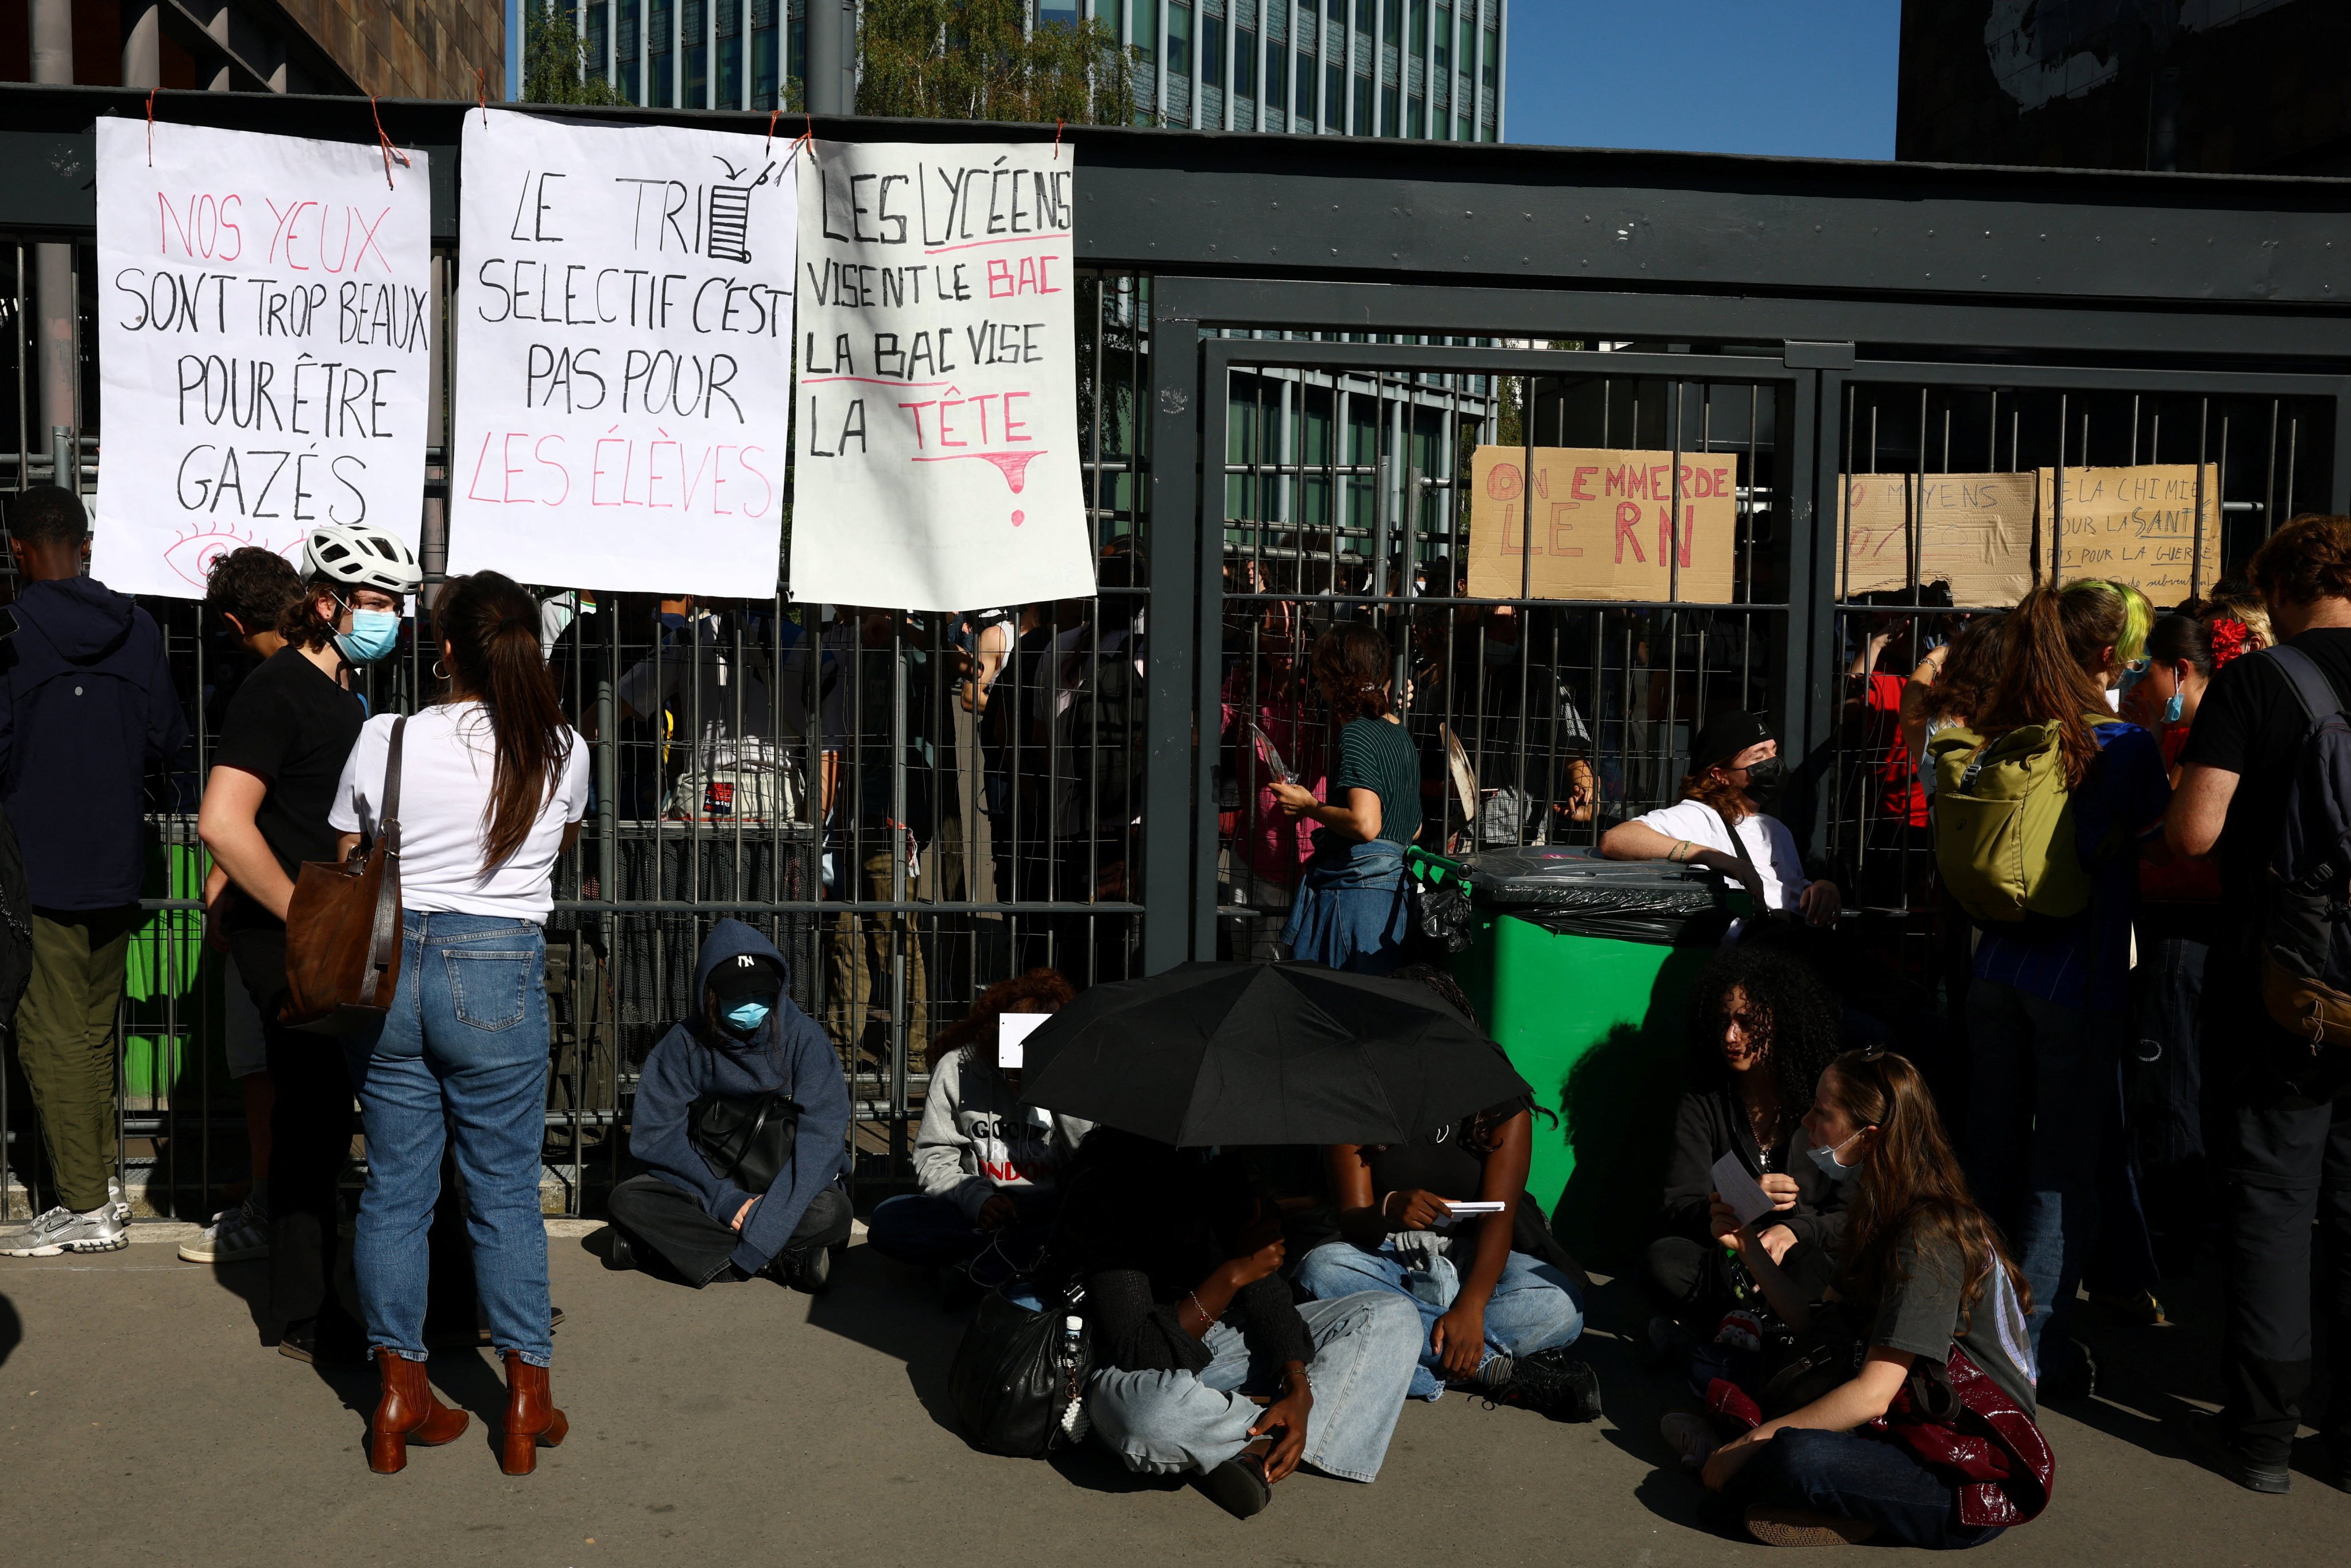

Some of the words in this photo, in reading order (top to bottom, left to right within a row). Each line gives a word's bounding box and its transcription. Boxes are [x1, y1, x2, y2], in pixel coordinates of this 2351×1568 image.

[158, 192, 242, 261] NOS
[265, 198, 391, 273] YEUX
[511, 170, 566, 242] LE
[615, 178, 702, 254] TRI
[822, 168, 908, 244] LES
[919, 155, 1072, 246] LYCÉENS
[115, 268, 237, 334] SONT
[248, 278, 326, 338] TROP
[339, 281, 428, 352] BEAUX
[478, 258, 687, 331] SELECTIF
[807, 257, 927, 308] VISENT
[936, 263, 972, 301] LE
[987, 255, 1063, 299] BAC
[527, 343, 606, 415] PAS
[623, 349, 745, 424] POUR
[806, 331, 853, 375] LA
[874, 327, 954, 381] BAC
[967, 319, 1045, 366] VISE
[177, 354, 282, 432] POUR
[293, 353, 397, 438] ÊTRE
[811, 395, 867, 457] LA
[898, 385, 1032, 450] TÊTE
[176, 443, 366, 525] GAZÉS
[468, 431, 570, 506] LES
[592, 424, 773, 518] ÉLÈVES
[1487, 463, 1548, 501] ON
[1571, 463, 1729, 501] EMMERDE
[2079, 478, 2104, 503] LA
[2117, 478, 2198, 501] CHIMIE
[1501, 502, 1583, 556] LE
[1615, 501, 1694, 568] RN
[2047, 548, 2072, 566] PS
[2082, 548, 2114, 564] POUR
[2123, 546, 2147, 561] LA
[2156, 546, 2213, 562] GUERE
[2048, 516, 2097, 537] POUR
[2107, 516, 2128, 532] LA
[978, 1157, 1058, 1182] ONDON
